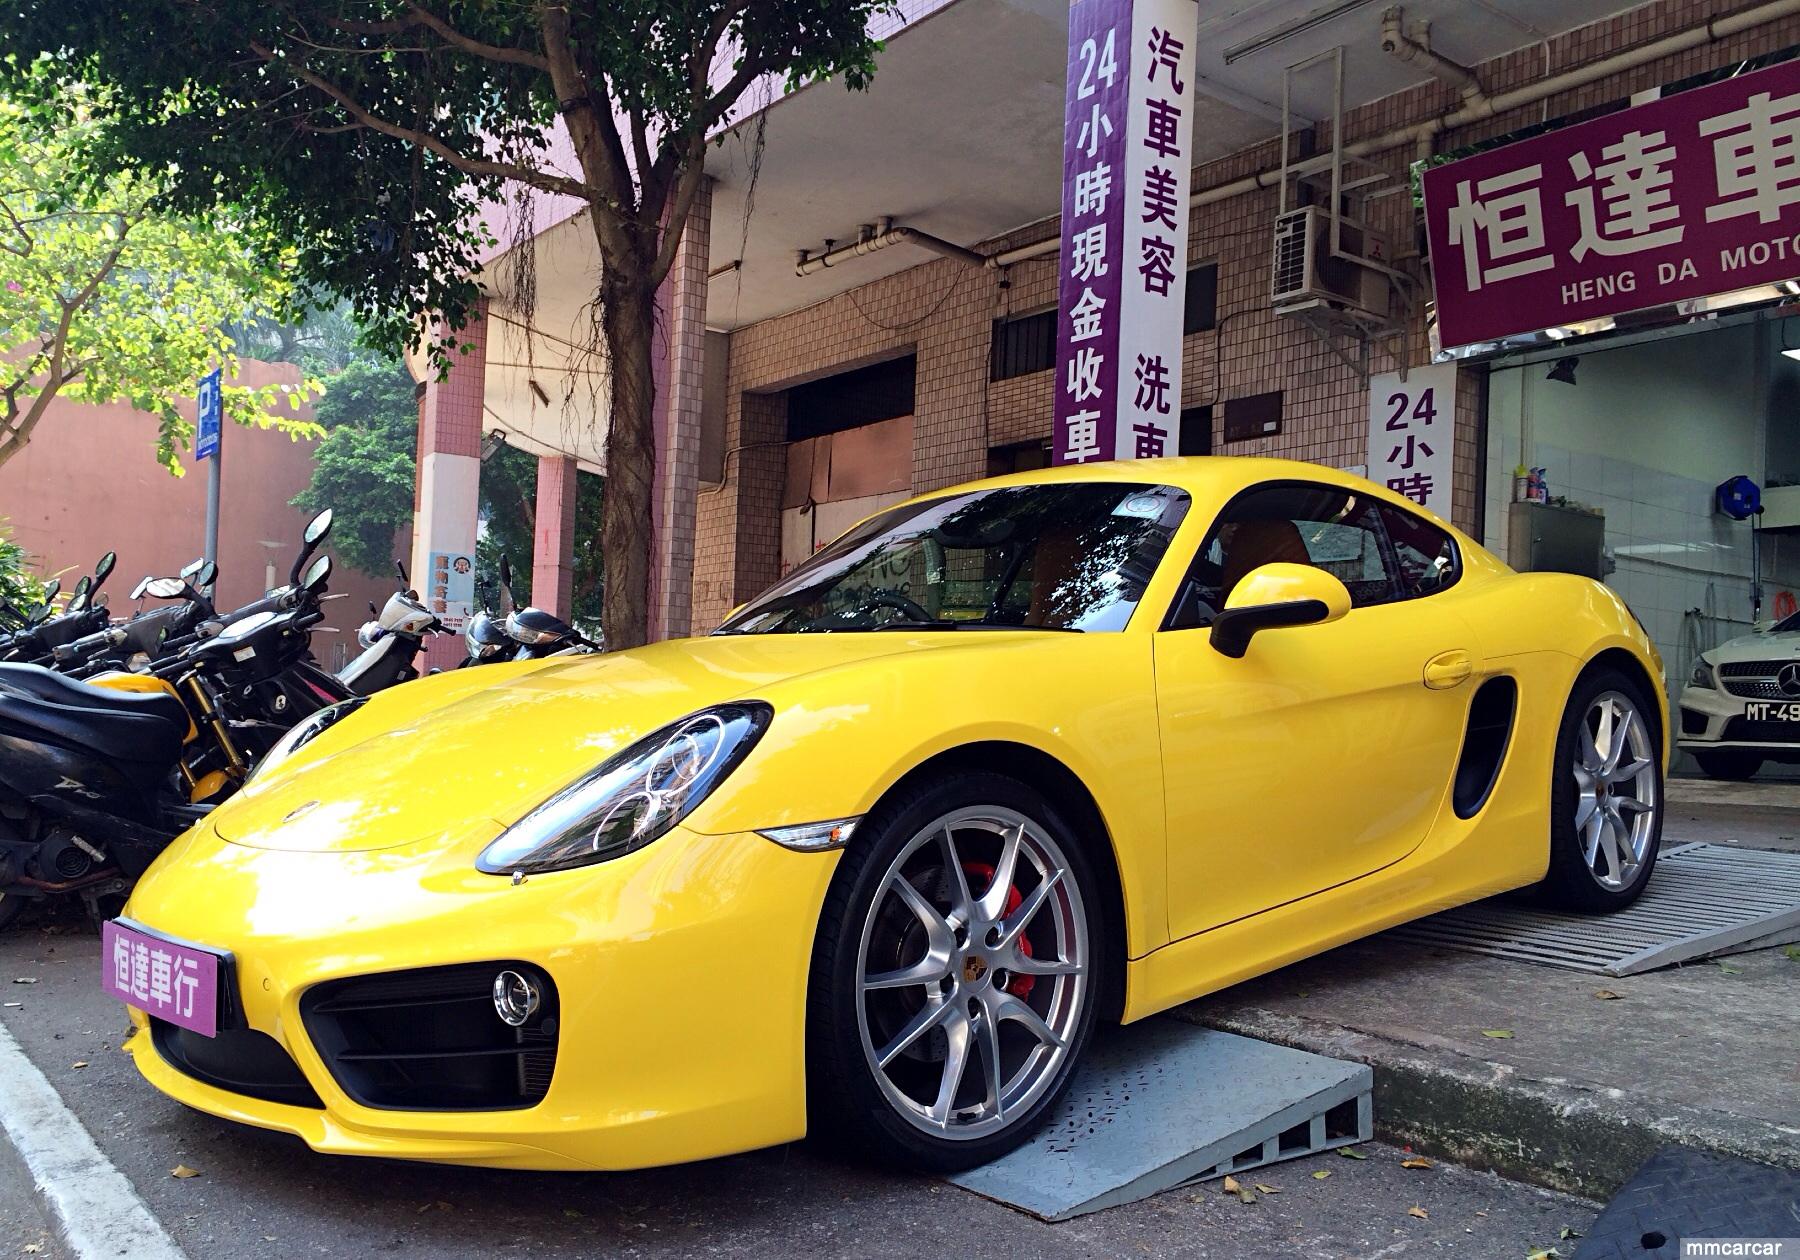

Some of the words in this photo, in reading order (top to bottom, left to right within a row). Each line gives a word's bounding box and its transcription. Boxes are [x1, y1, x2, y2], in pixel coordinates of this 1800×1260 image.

[1138, 26, 1184, 297] 汽車美容
[1448, 91, 1800, 292] 恒達車
[1063, 27, 1116, 464] 24小時現金收車
[1561, 270, 1636, 305] HENG
[1658, 258, 1698, 285] DA
[1132, 353, 1171, 459] 洗車
[1385, 387, 1437, 506] 24小時
[114, 933, 199, 1018] 恒達車行
